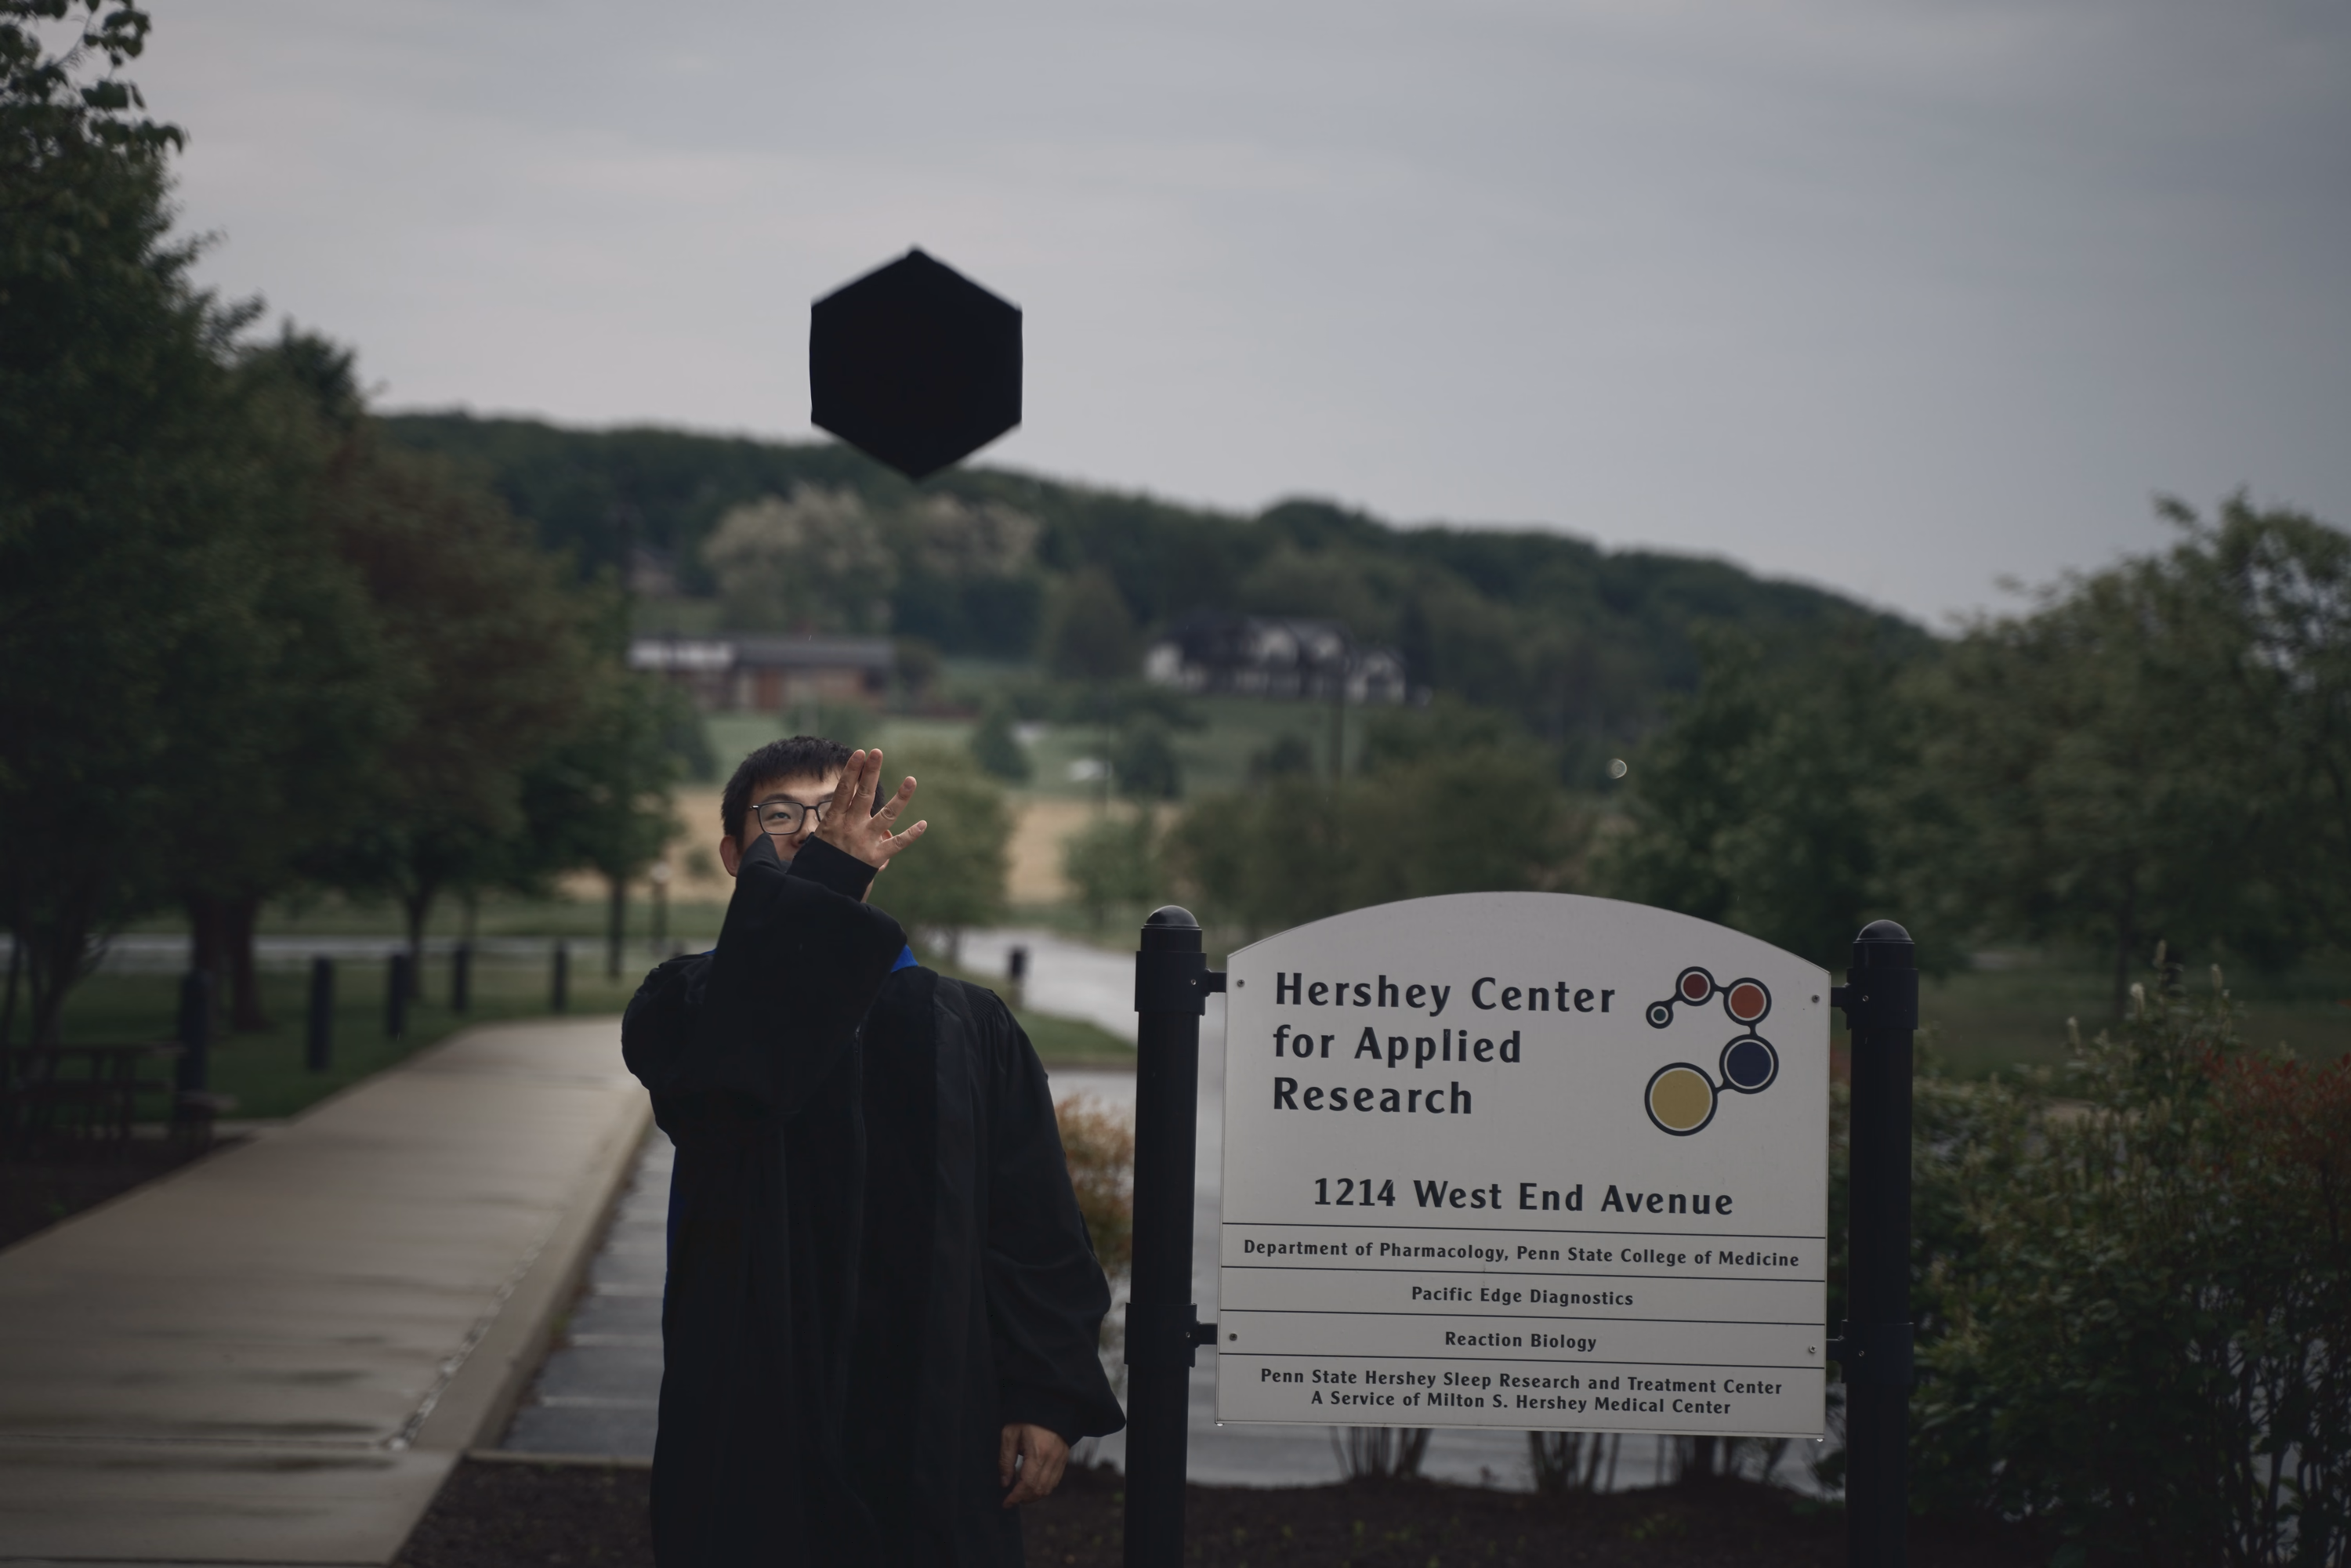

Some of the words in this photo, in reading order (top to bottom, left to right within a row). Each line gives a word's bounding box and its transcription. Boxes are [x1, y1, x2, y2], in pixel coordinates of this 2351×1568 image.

[1276, 972, 1451, 1017] Hershey
[1471, 976, 1615, 1013] Center
[1273, 1024, 1335, 1059] for
[1354, 1027, 1520, 1069] Applied
[1273, 1077, 1472, 1114] Research
[1314, 1178, 1396, 1207] 1214
[1413, 1179, 1502, 1210] West
[1520, 1182, 1583, 1211] End
[1600, 1184, 1733, 1215] Avenue
[1244, 1239, 1348, 1257] Department
[1355, 1242, 1374, 1256] of
[1380, 1242, 1509, 1262] Pharmacology,
[1517, 1245, 1559, 1261] Penn
[1567, 1247, 1613, 1262] State
[1621, 1248, 1686, 1267] College
[1694, 1250, 1712, 1265] of
[1719, 1251, 1799, 1267] Medicine
[1412, 1286, 1473, 1302] Pacific
[1480, 1287, 1522, 1305] Edge
[1531, 1289, 1633, 1307] Diagnostics
[1445, 1331, 1522, 1347] Reaction
[1531, 1333, 1596, 1353] Biology
[1261, 1368, 1304, 1383] Penn
[1312, 1369, 1357, 1384] State
[1365, 1370, 1436, 1389] Hershey
[1444, 1371, 1491, 1390] Sleep
[1500, 1373, 1580, 1389] Research
[1588, 1376, 1620, 1390] and
[1627, 1376, 1716, 1393] Treatment
[1723, 1379, 1782, 1395] Center
[1311, 1390, 1323, 1405] A
[1331, 1390, 1395, 1406] Service
[1403, 1392, 1421, 1407] of
[1427, 1392, 1484, 1407] Milton
[1492, 1393, 1508, 1408] S.
[1516, 1394, 1587, 1414] Hershey
[1594, 1396, 1664, 1412] Medical
[1672, 1399, 1731, 1414] Center
